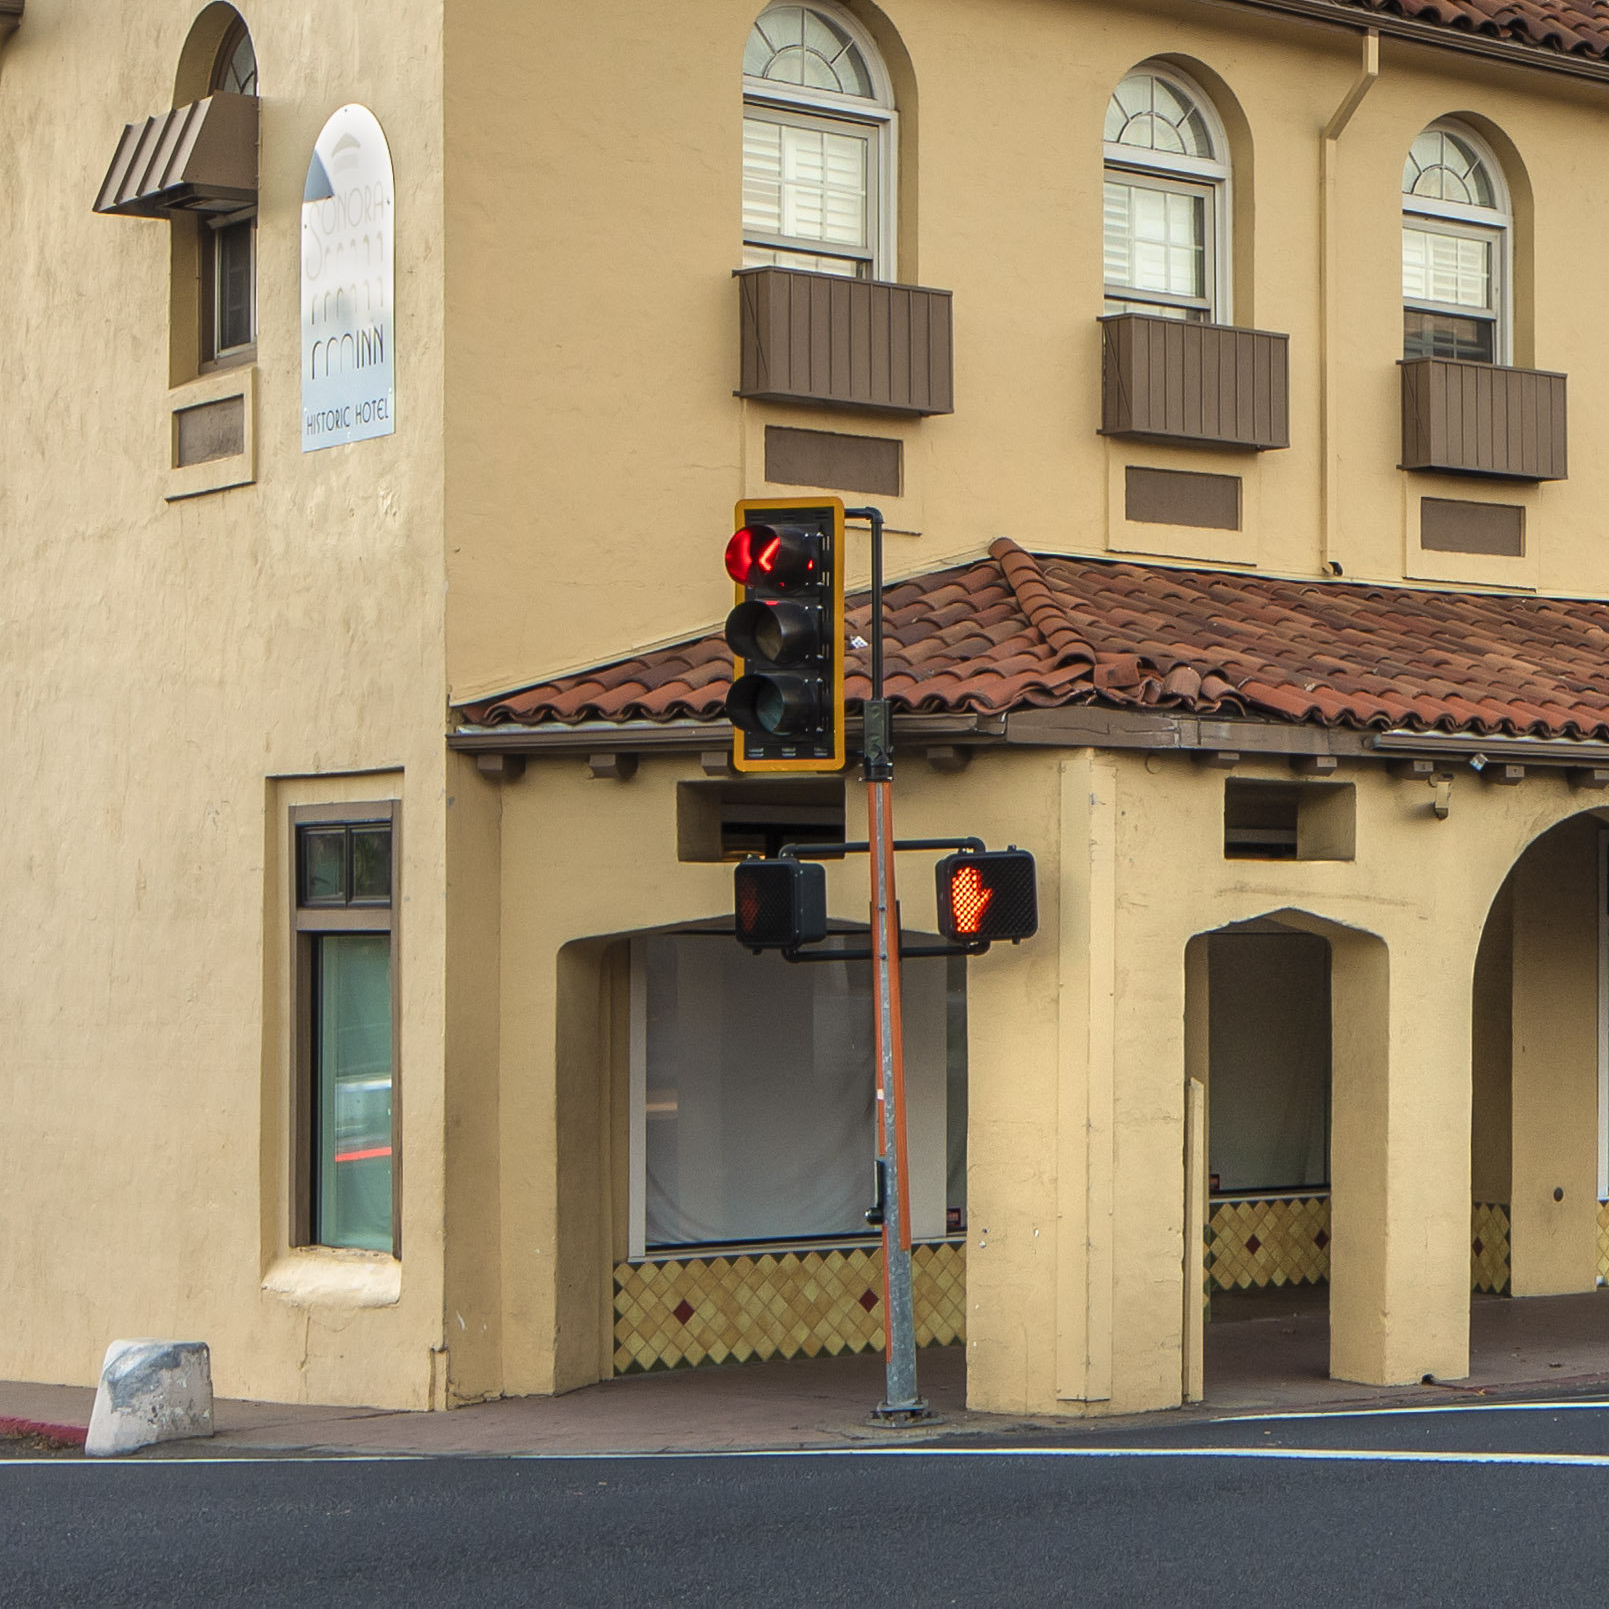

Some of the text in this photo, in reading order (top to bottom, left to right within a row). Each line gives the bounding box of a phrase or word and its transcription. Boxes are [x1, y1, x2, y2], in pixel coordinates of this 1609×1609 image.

[356, 323, 384, 369] INN
[306, 397, 389, 436] HISTORIC HOTEL
